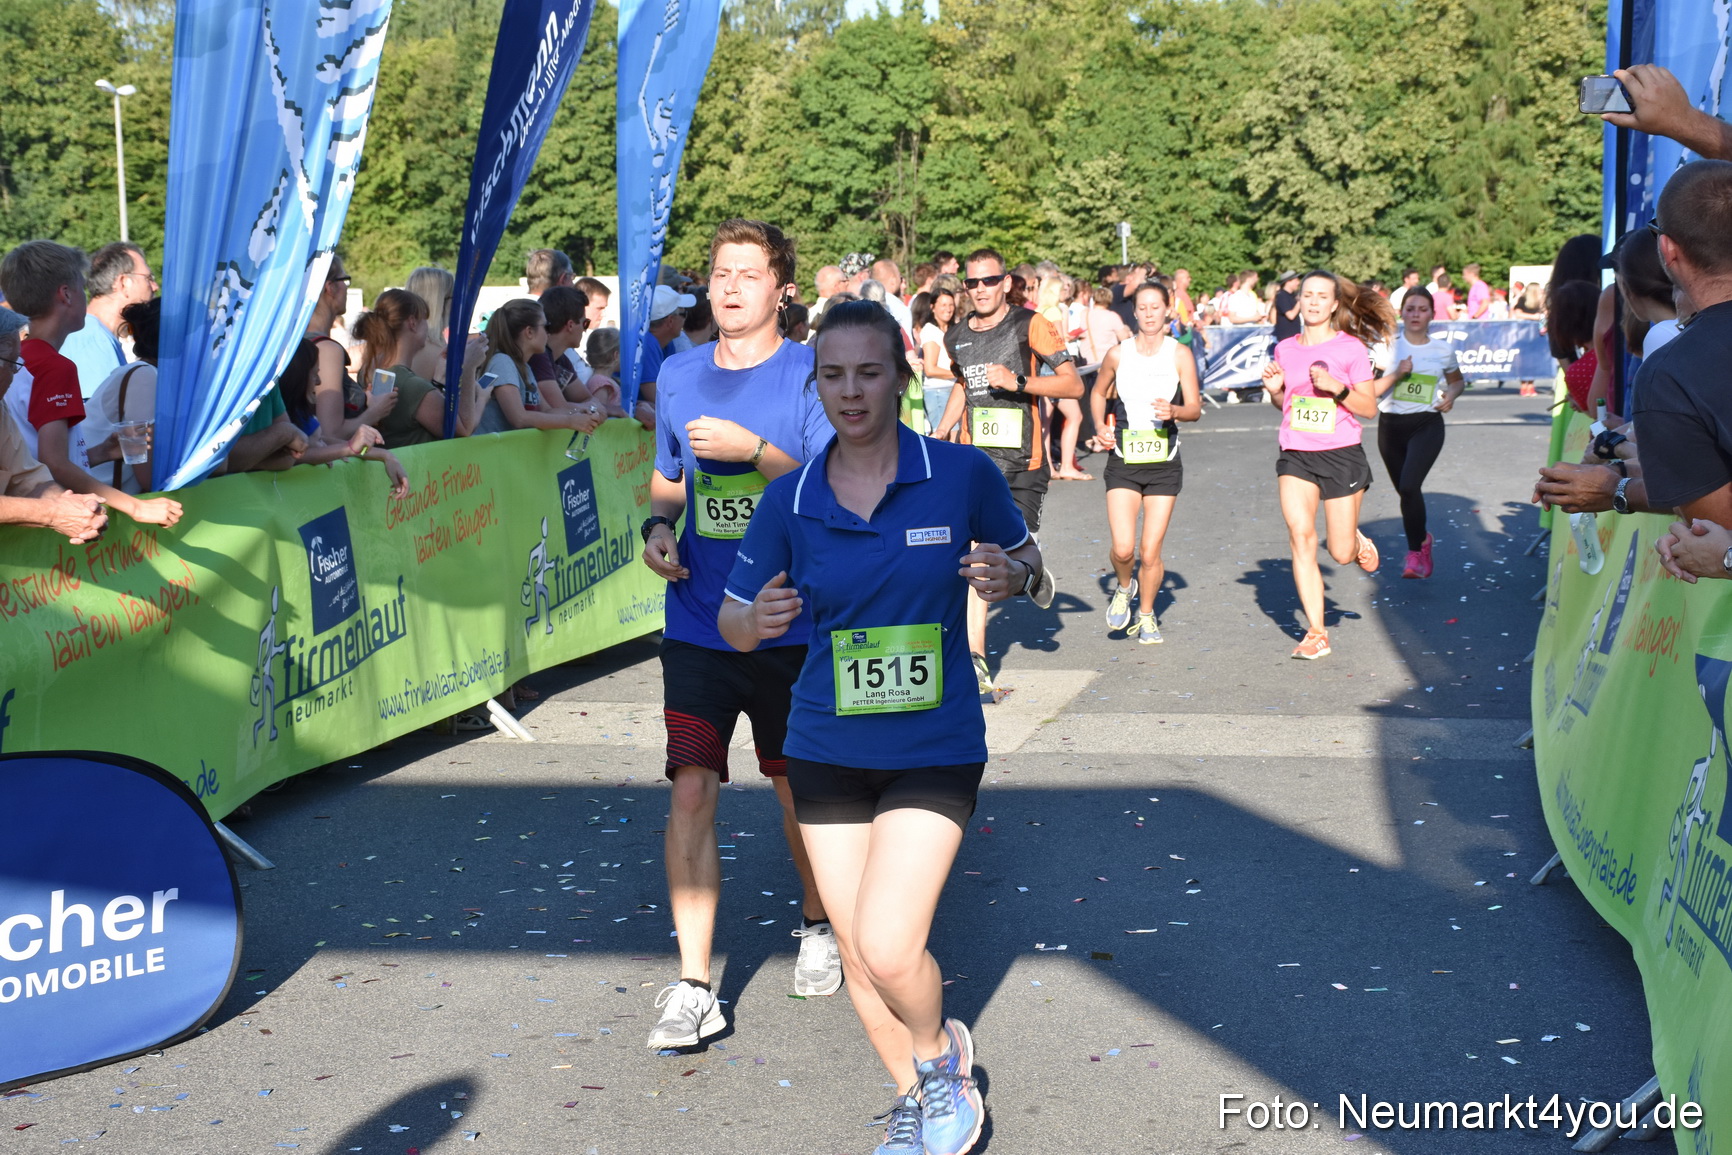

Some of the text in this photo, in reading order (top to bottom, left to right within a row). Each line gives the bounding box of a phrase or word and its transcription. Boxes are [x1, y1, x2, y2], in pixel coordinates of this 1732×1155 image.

[1407, 383, 1422, 395] 60
[1296, 408, 1329, 423] 1437
[1129, 440, 1162, 453] 1379
[441, 463, 483, 502] Firmen
[567, 488, 590, 511] Fischer
[706, 497, 755, 521] 653
[413, 487, 499, 566] laufen länger!
[0, 529, 161, 623] esunde Firmen
[317, 545, 348, 576] Fischer
[554, 513, 635, 606] firmenlauf
[44, 558, 201, 673] laufen länger!
[558, 588, 596, 626] neumarkt
[283, 574, 407, 700] firmenlauf
[847, 655, 929, 689] 1515
[285, 676, 354, 729] neumarkt
[865, 688, 911, 699] Lang Rosa
[875, 697, 906, 706] Ingenieure
